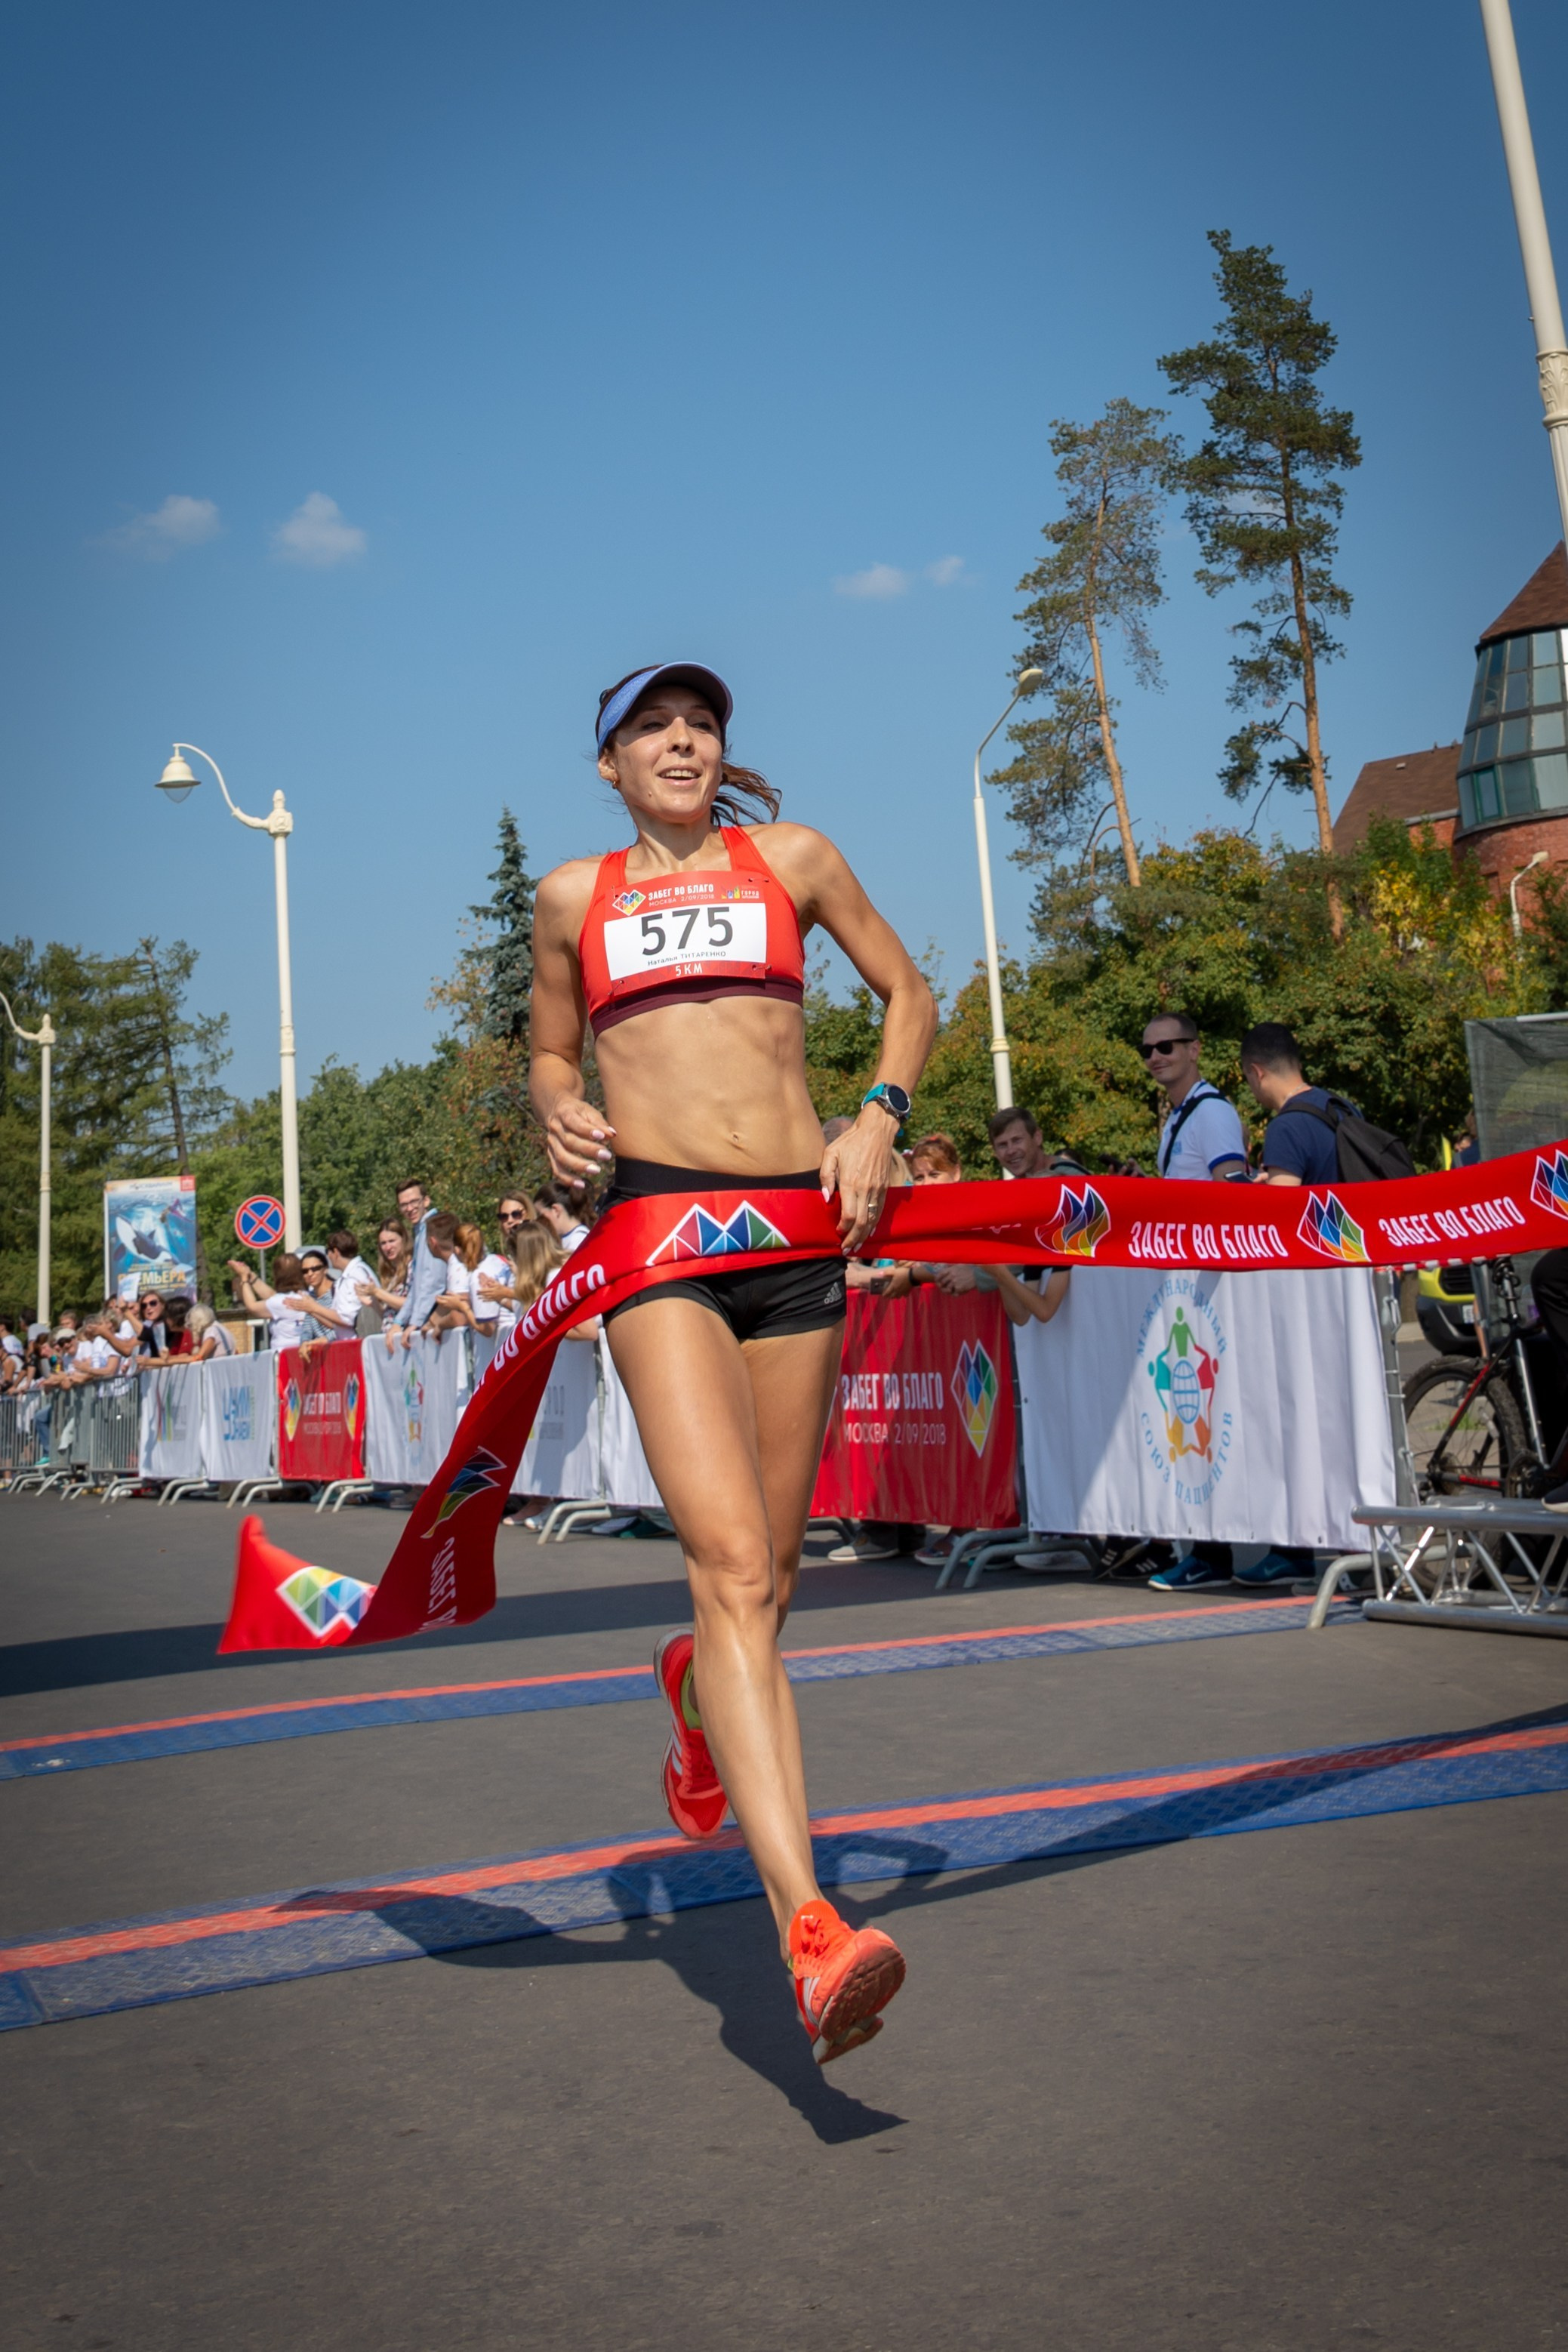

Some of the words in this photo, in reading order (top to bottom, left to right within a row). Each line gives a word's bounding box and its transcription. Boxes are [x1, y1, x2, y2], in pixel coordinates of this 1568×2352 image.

[648, 888, 673, 901] ЗАБЕГ
[674, 886, 685, 895] ВО
[687, 884, 714, 894] БЛАГО
[648, 897, 677, 907] МОСКВА
[642, 906, 733, 955] 575
[1128, 1221, 1188, 1259] ЗАБЕГ
[1192, 1223, 1221, 1259] ВО
[1221, 1224, 1289, 1259] БЛАГО
[1378, 1213, 1441, 1247] ЗАБЕГ
[1433, 1209, 1469, 1239] ВО
[1459, 1196, 1526, 1235] БЛАГО
[842, 1372, 880, 1410] ЗАБЕГ
[883, 1373, 900, 1410] ВО
[903, 1372, 944, 1410] БЛАГО
[843, 1423, 889, 1444] МОСКВА
[1140, 1412, 1170, 1483] СОЮЗ
[1175, 1412, 1233, 1505] ПАЦИЕНТОВ
